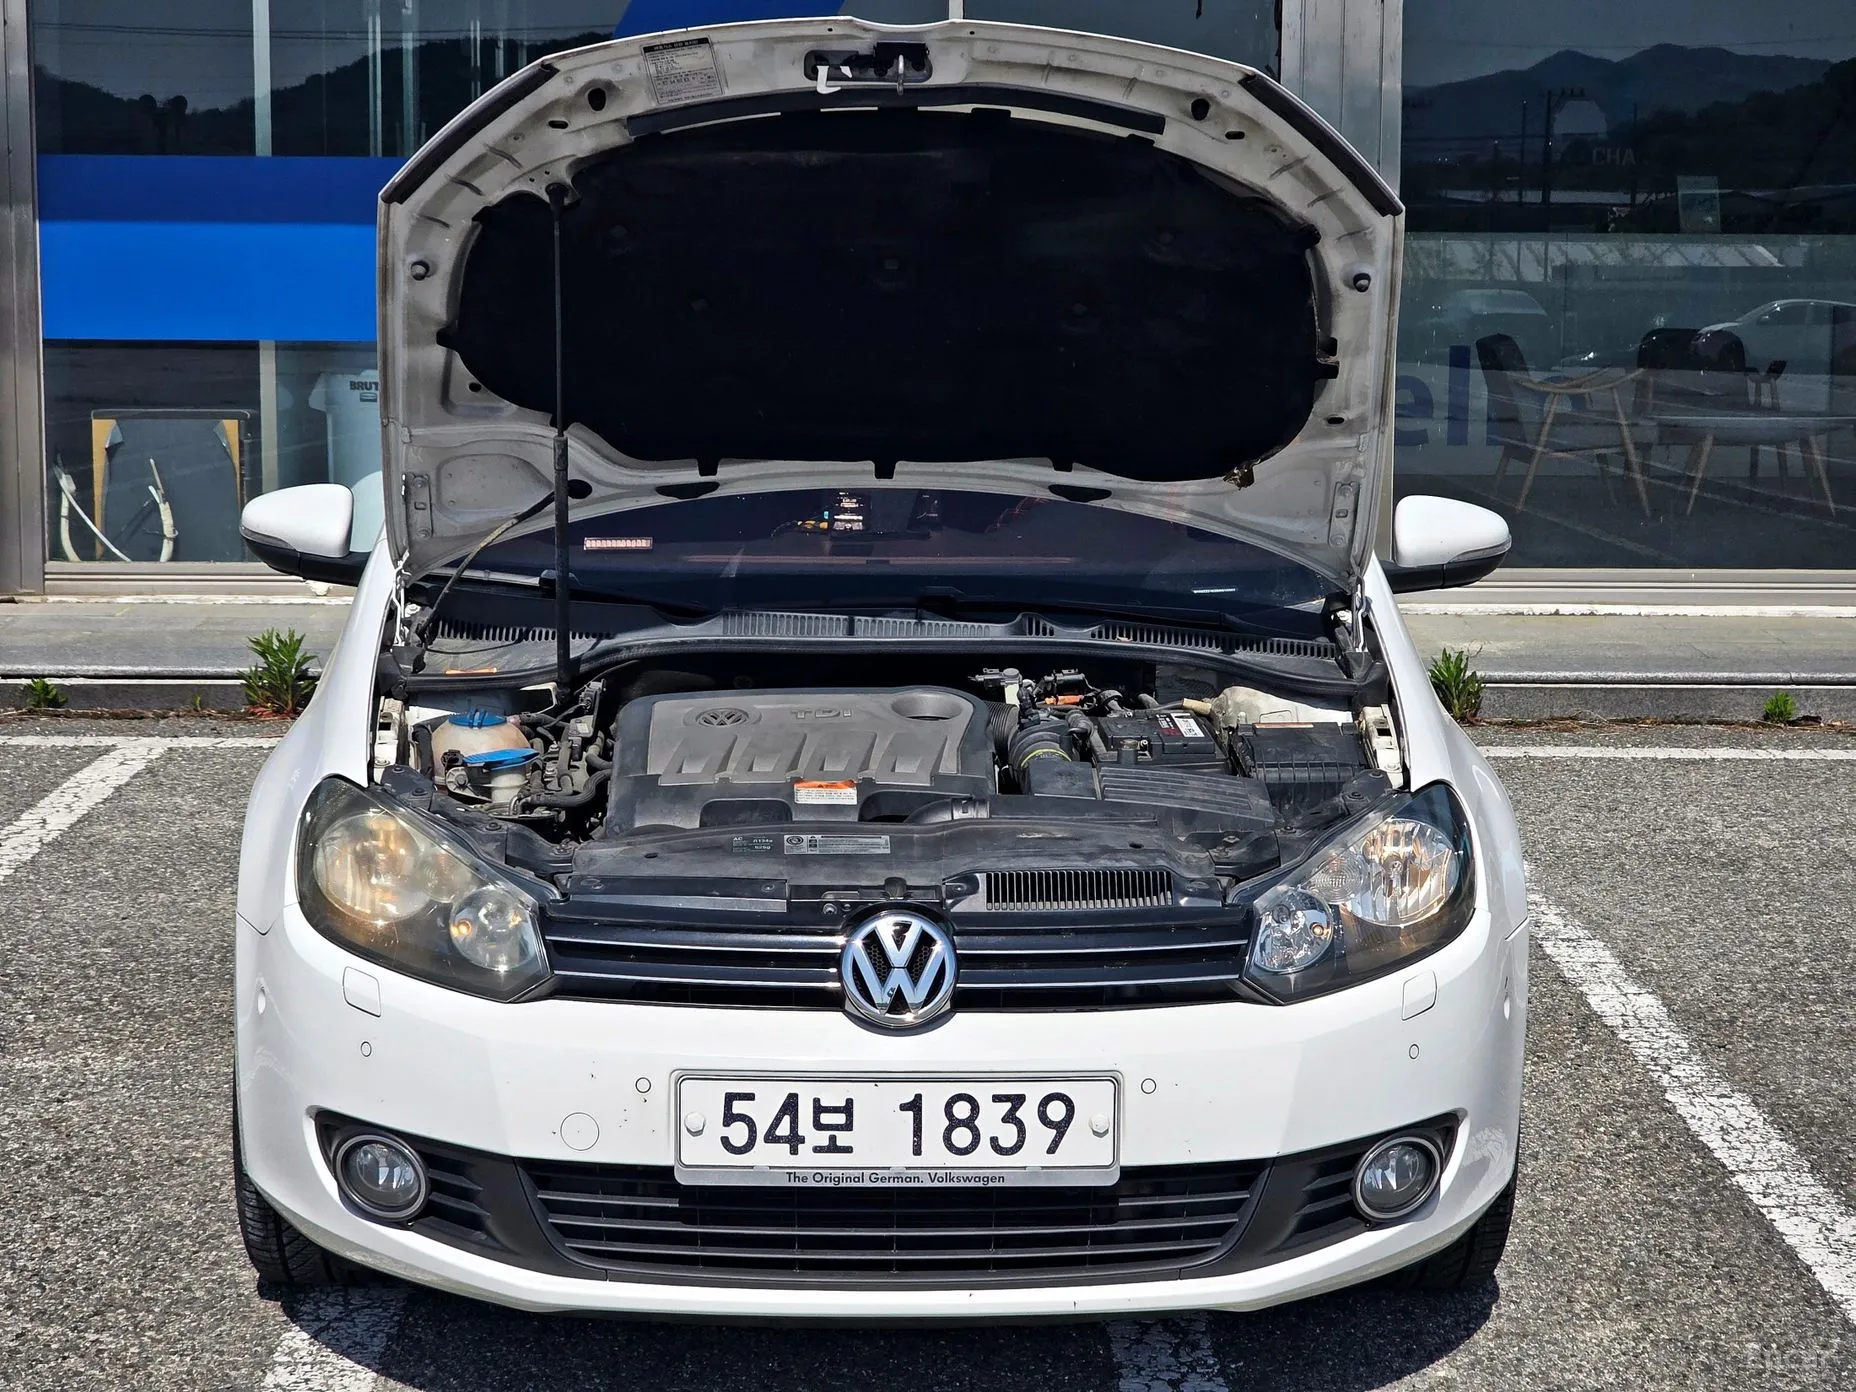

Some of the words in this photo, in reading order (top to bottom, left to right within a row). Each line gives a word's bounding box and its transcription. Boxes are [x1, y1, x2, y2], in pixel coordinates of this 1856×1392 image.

[790, 708, 853, 720] TDI
[719, 1091, 854, 1156] 54보
[898, 1091, 1076, 1157] 1839
[786, 1172, 808, 1183] The
[812, 1171, 865, 1185] Original
[868, 1171, 924, 1184] German.
[927, 1171, 1005, 1186] Volkswagen
